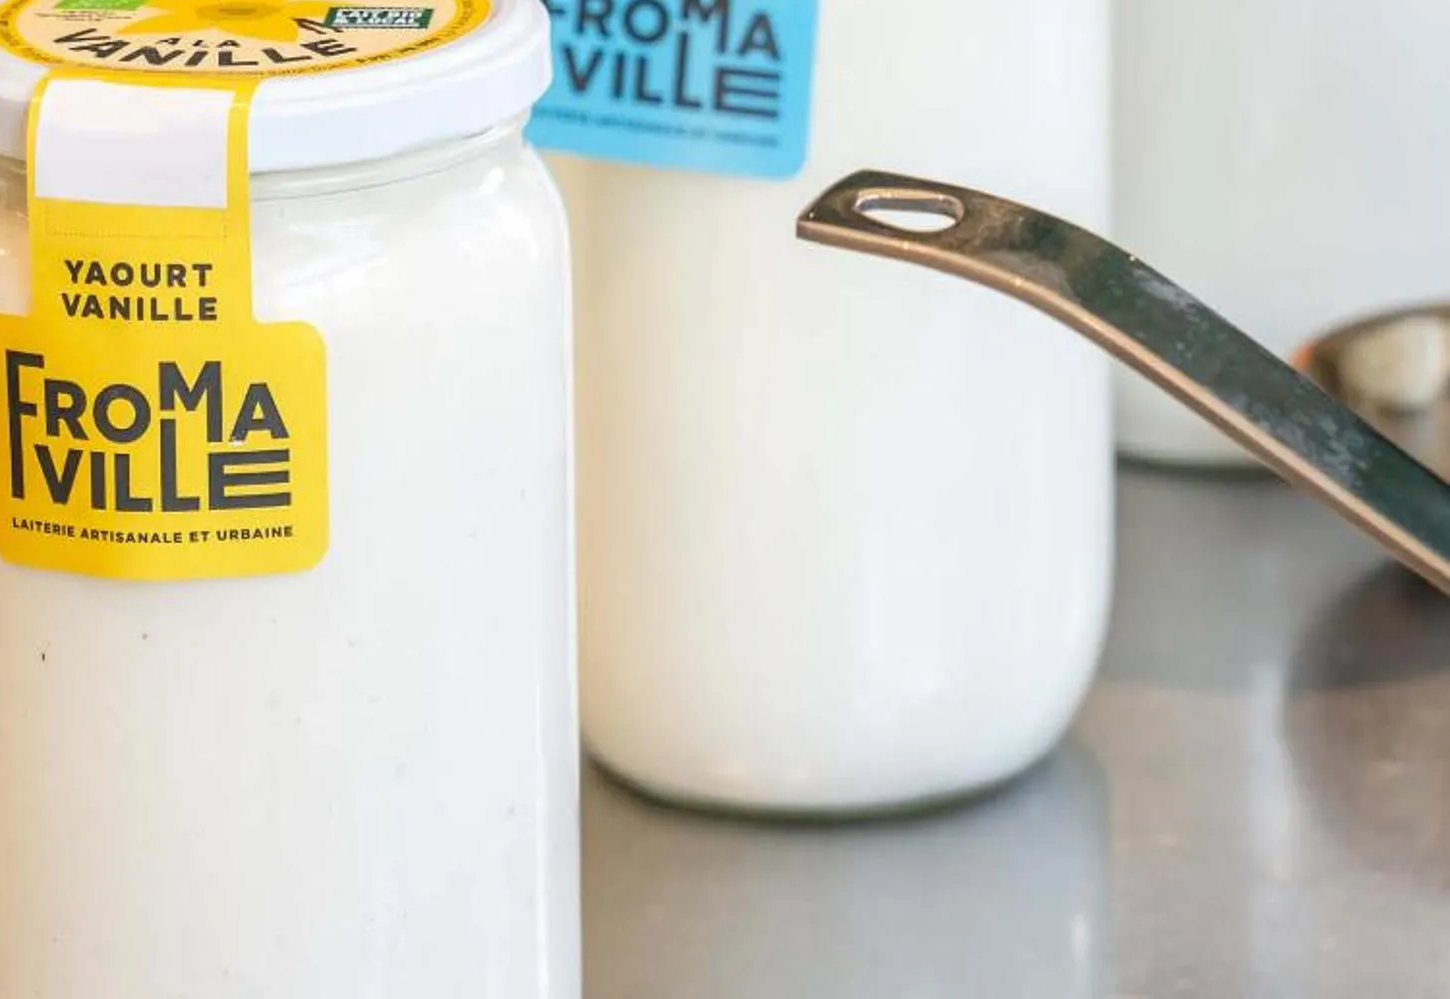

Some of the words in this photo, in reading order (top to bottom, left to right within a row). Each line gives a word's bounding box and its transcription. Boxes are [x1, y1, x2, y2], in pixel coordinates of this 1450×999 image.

[53, 28, 357, 67] VANILLE
[561, 31, 781, 118] VILLE
[63, 259, 215, 288] YAOURT
[60, 292, 218, 322] VANILLE
[5, 348, 289, 500] FROMA
[34, 418, 291, 513] VILLE
[11, 516, 75, 538] LAITERIE
[80, 527, 183, 544] ARTISANALE
[189, 530, 210, 543] ET
[216, 525, 294, 542] URBAINE
